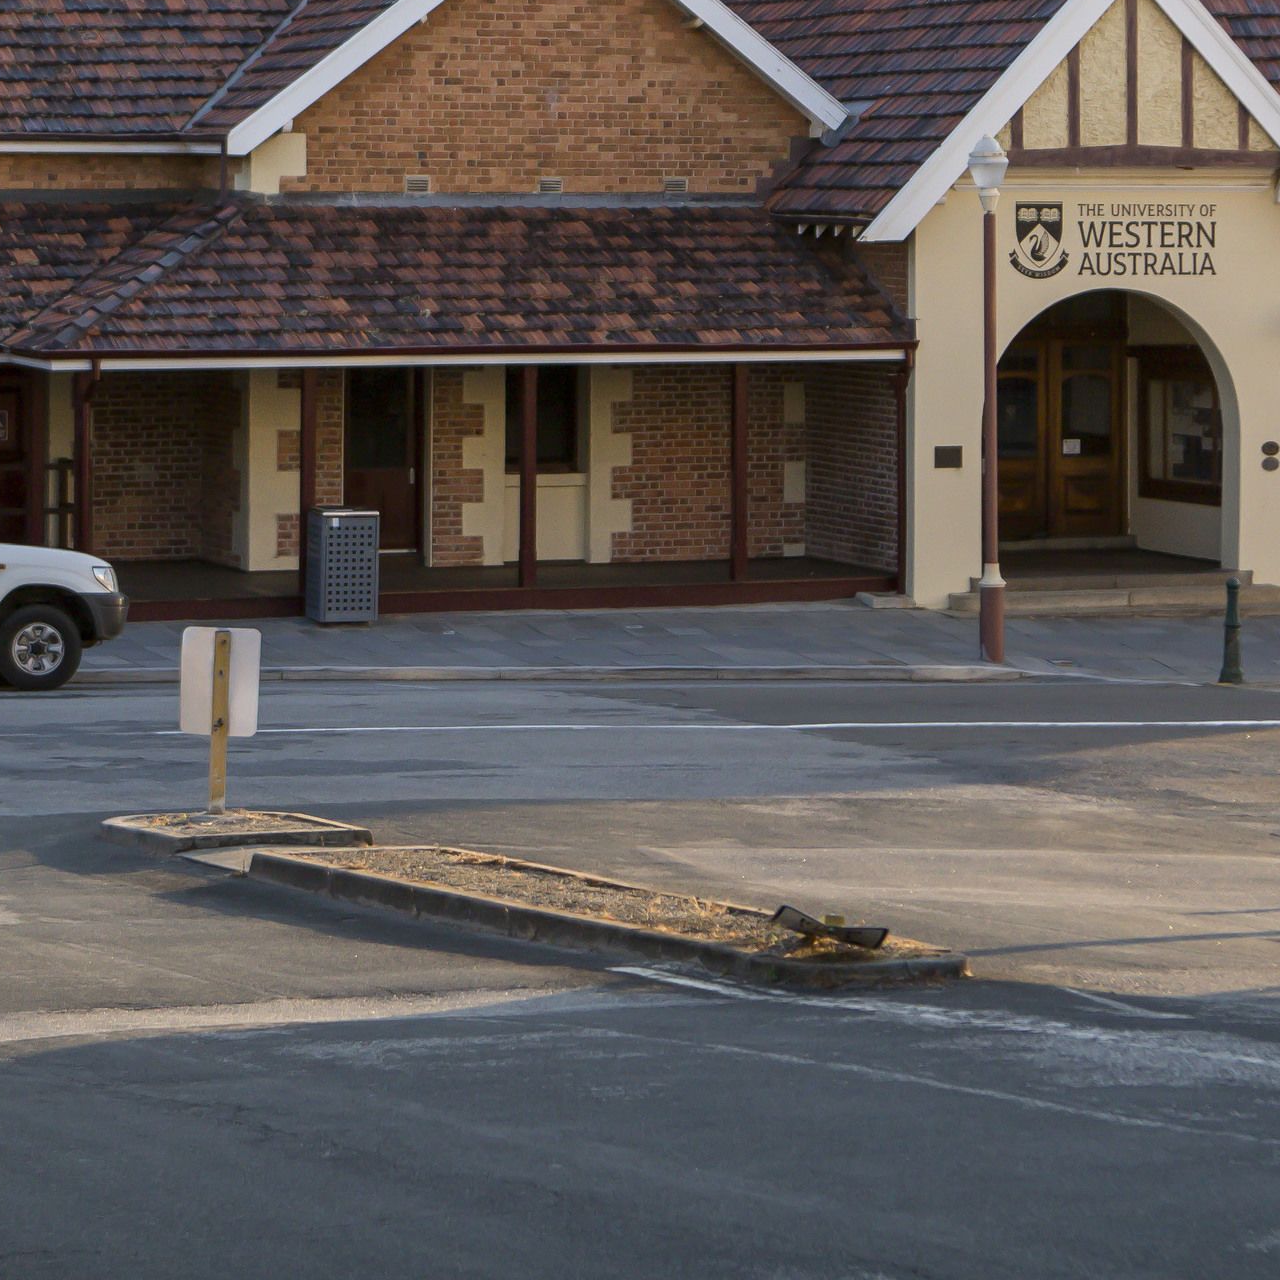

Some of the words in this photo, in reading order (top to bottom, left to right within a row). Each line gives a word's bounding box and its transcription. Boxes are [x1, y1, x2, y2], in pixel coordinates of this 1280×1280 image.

[1077, 203, 1105, 217] THE
[1111, 203, 1196, 217] UNIVERSITY
[1199, 203, 1217, 217] OF
[1077, 221, 1217, 248] WESTERN
[1077, 252, 1217, 276] AUSTRALIA
